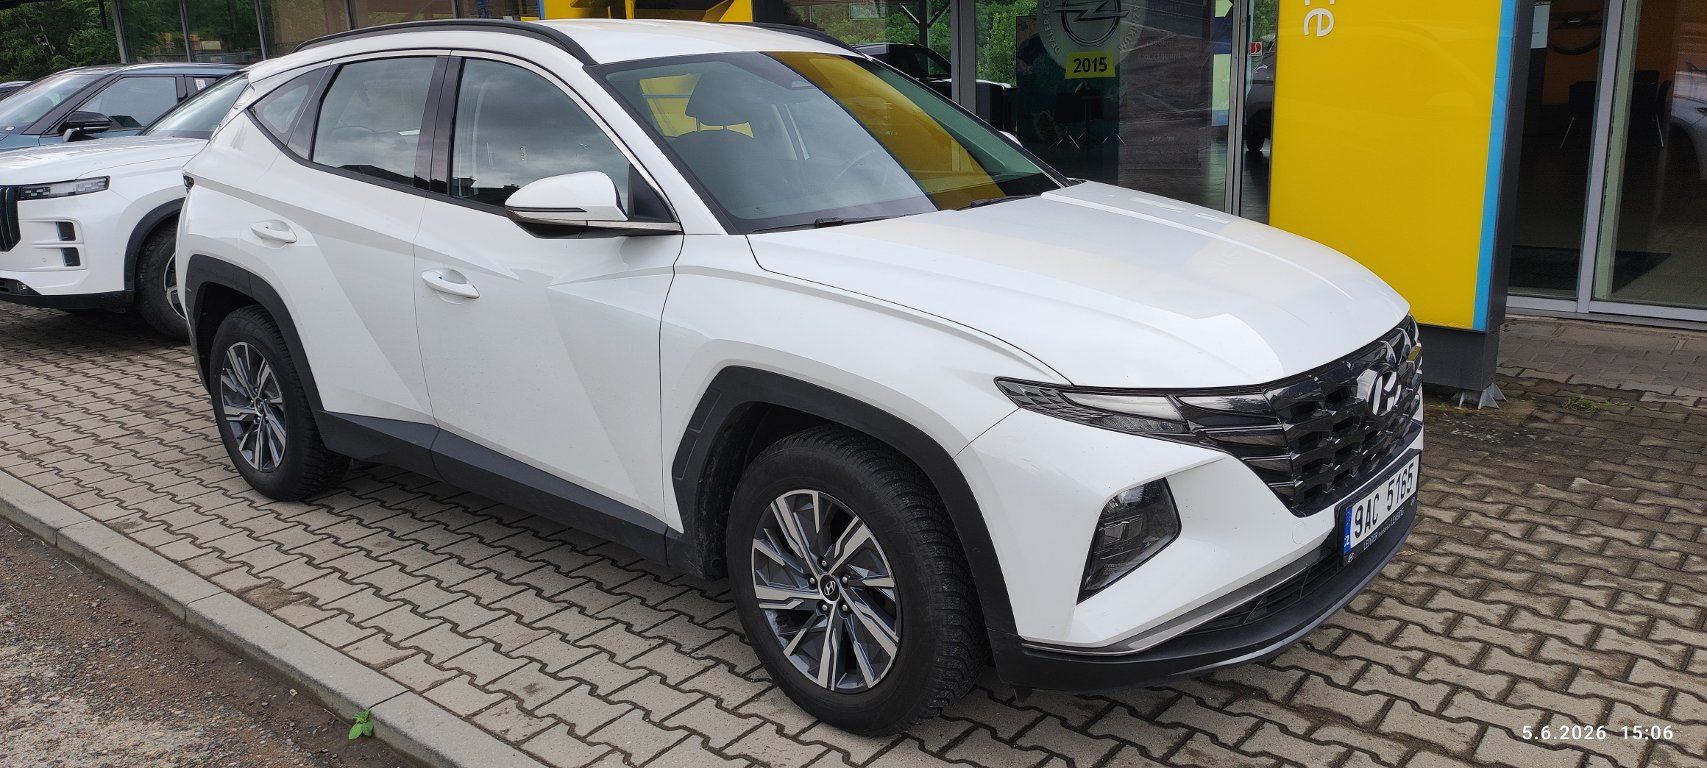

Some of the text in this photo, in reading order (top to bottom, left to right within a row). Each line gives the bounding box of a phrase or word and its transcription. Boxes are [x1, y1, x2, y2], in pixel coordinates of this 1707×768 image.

[1303, 0, 1335, 37] e
[1073, 56, 1108, 73] 2015
[1355, 493, 1379, 538] 9AC
[1387, 462, 1414, 511] 5165
